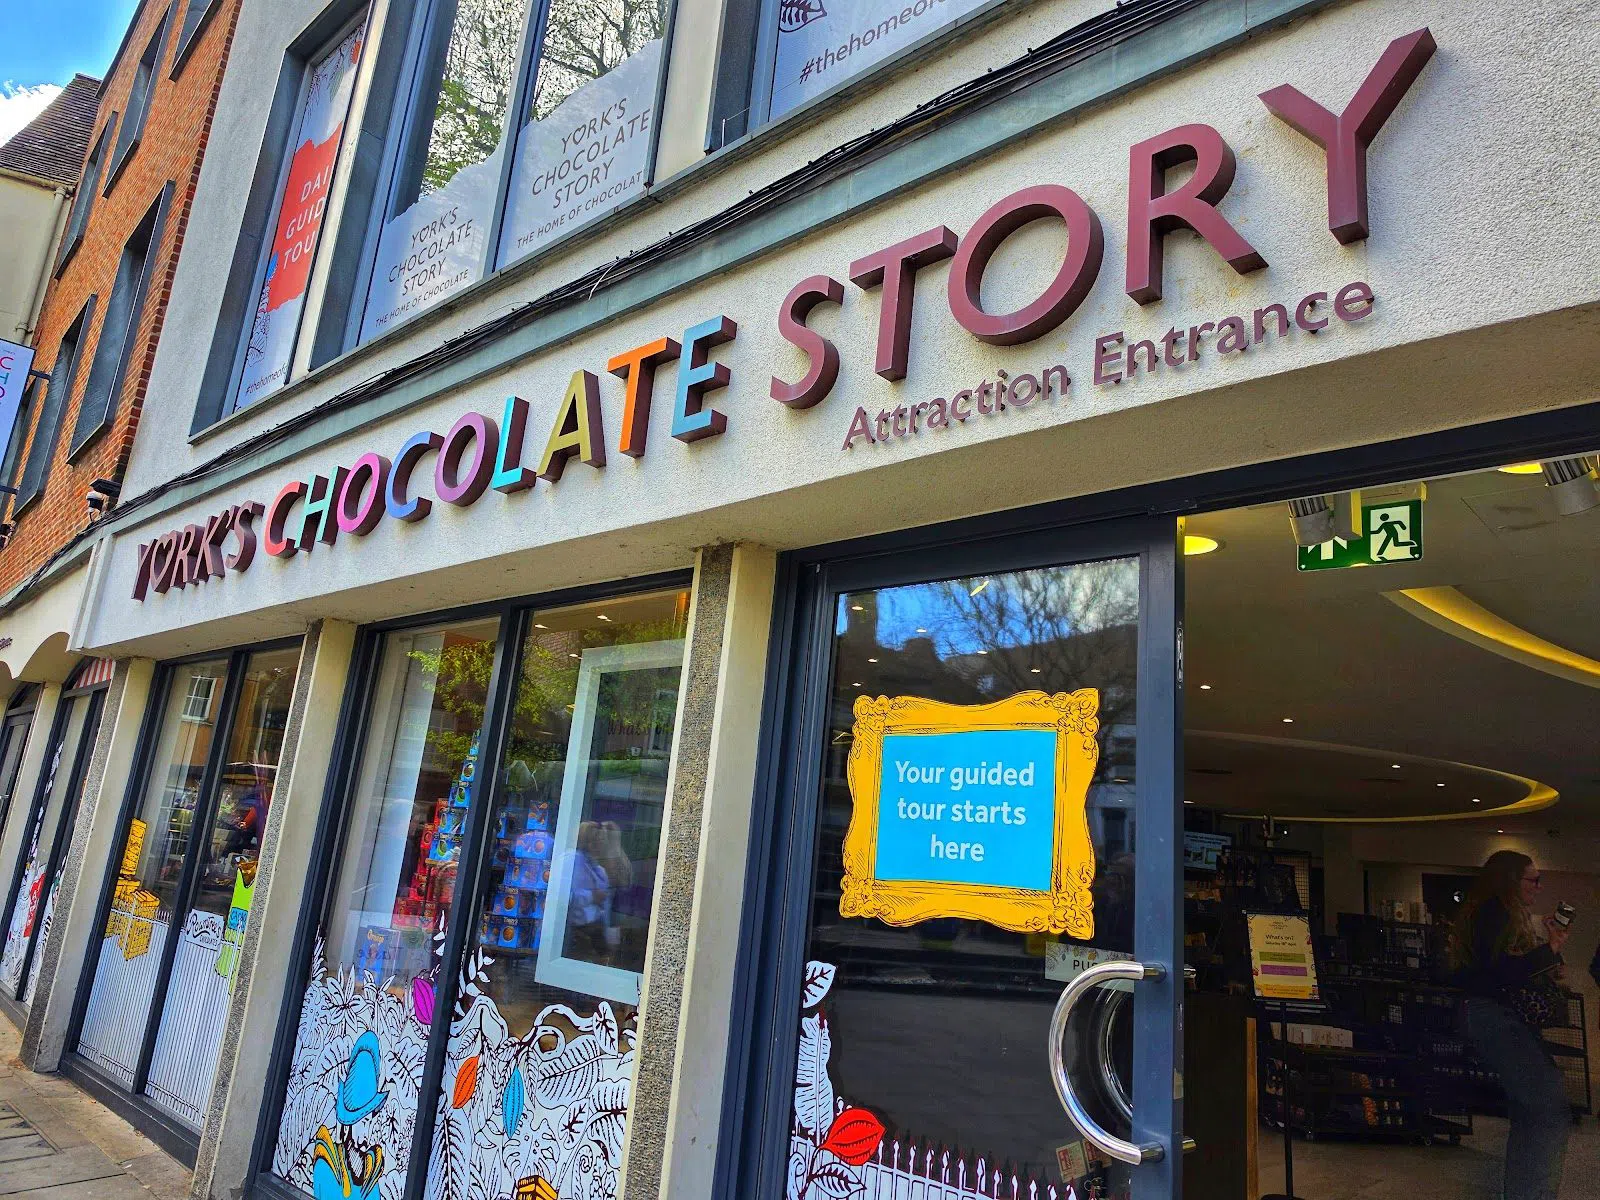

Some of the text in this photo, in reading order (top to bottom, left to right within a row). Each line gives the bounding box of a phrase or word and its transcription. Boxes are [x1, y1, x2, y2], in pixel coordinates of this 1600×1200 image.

[561, 98, 627, 154] YORK'S
[532, 109, 650, 196] CHOCOLATE
[552, 157, 614, 209] STORY
[388, 219, 473, 283] CHOCOLATE
[411, 206, 459, 249] YORK'S
[517, 231, 535, 248] THE
[537, 215, 566, 238] HOME
[568, 205, 582, 220] OF
[375, 269, 469, 328] THE HOME OF CHOCOLATE
[402, 257, 447, 296] STORY
[131, 26, 1437, 602] YORK'S CHOCOLATE STORY
[841, 280, 1375, 451] Attraction Entrance
[895, 760, 1036, 791] Your guided
[897, 797, 1027, 826] tour starts
[929, 833, 986, 863] here
